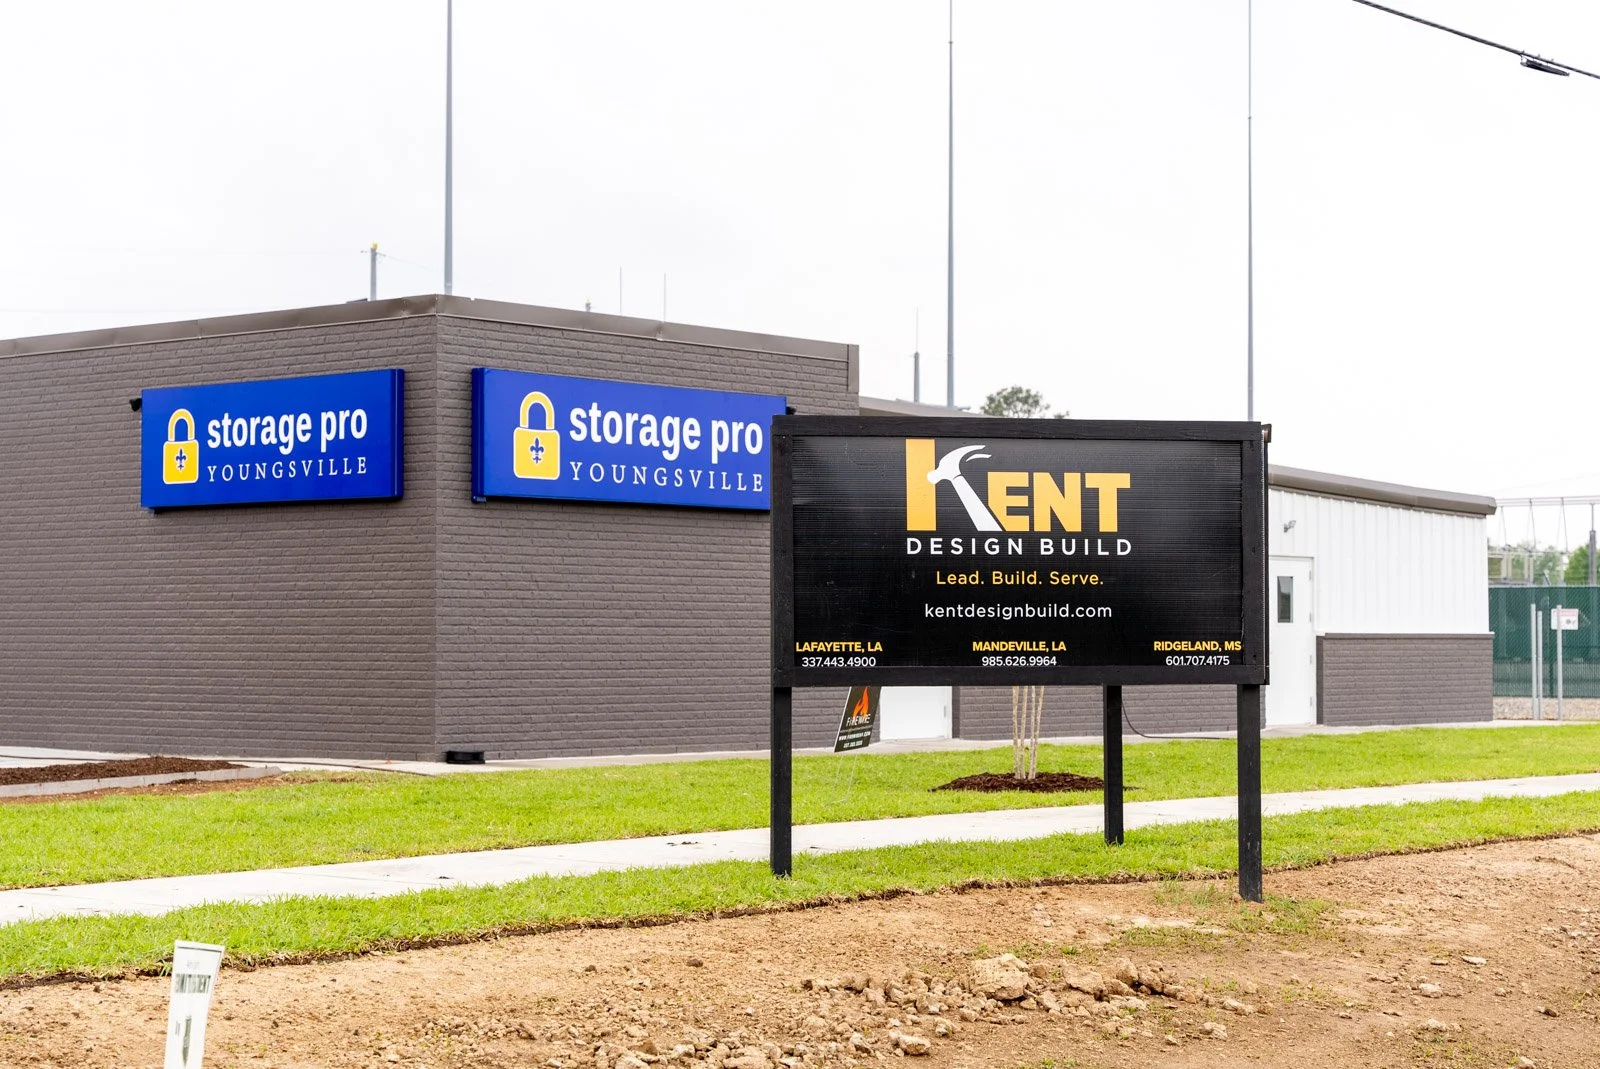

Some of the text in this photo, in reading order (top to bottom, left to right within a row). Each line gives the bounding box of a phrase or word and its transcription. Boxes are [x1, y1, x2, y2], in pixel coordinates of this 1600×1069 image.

[207, 407, 368, 457] storage pro
[569, 401, 764, 464] storage pro
[207, 456, 368, 483] YOUNGSVILLE
[569, 460, 764, 493] YOUNGSVILLE
[905, 438, 1132, 533] KENT
[906, 537, 1132, 556] DESIGN BUILD
[936, 570, 1104, 586] Lead. Build. Serve.
[925, 603, 1113, 621] kentdesignbuild.com
[795, 641, 883, 653] LAFAYETTE, LA
[972, 640, 1067, 653] MANDEVILLE, LA
[1153, 640, 1242, 652] RIDGELAND, MS
[801, 656, 877, 668] 337.443.4900
[981, 655, 1058, 667] 985.626.9964
[1165, 655, 1231, 667] 601.707.4175
